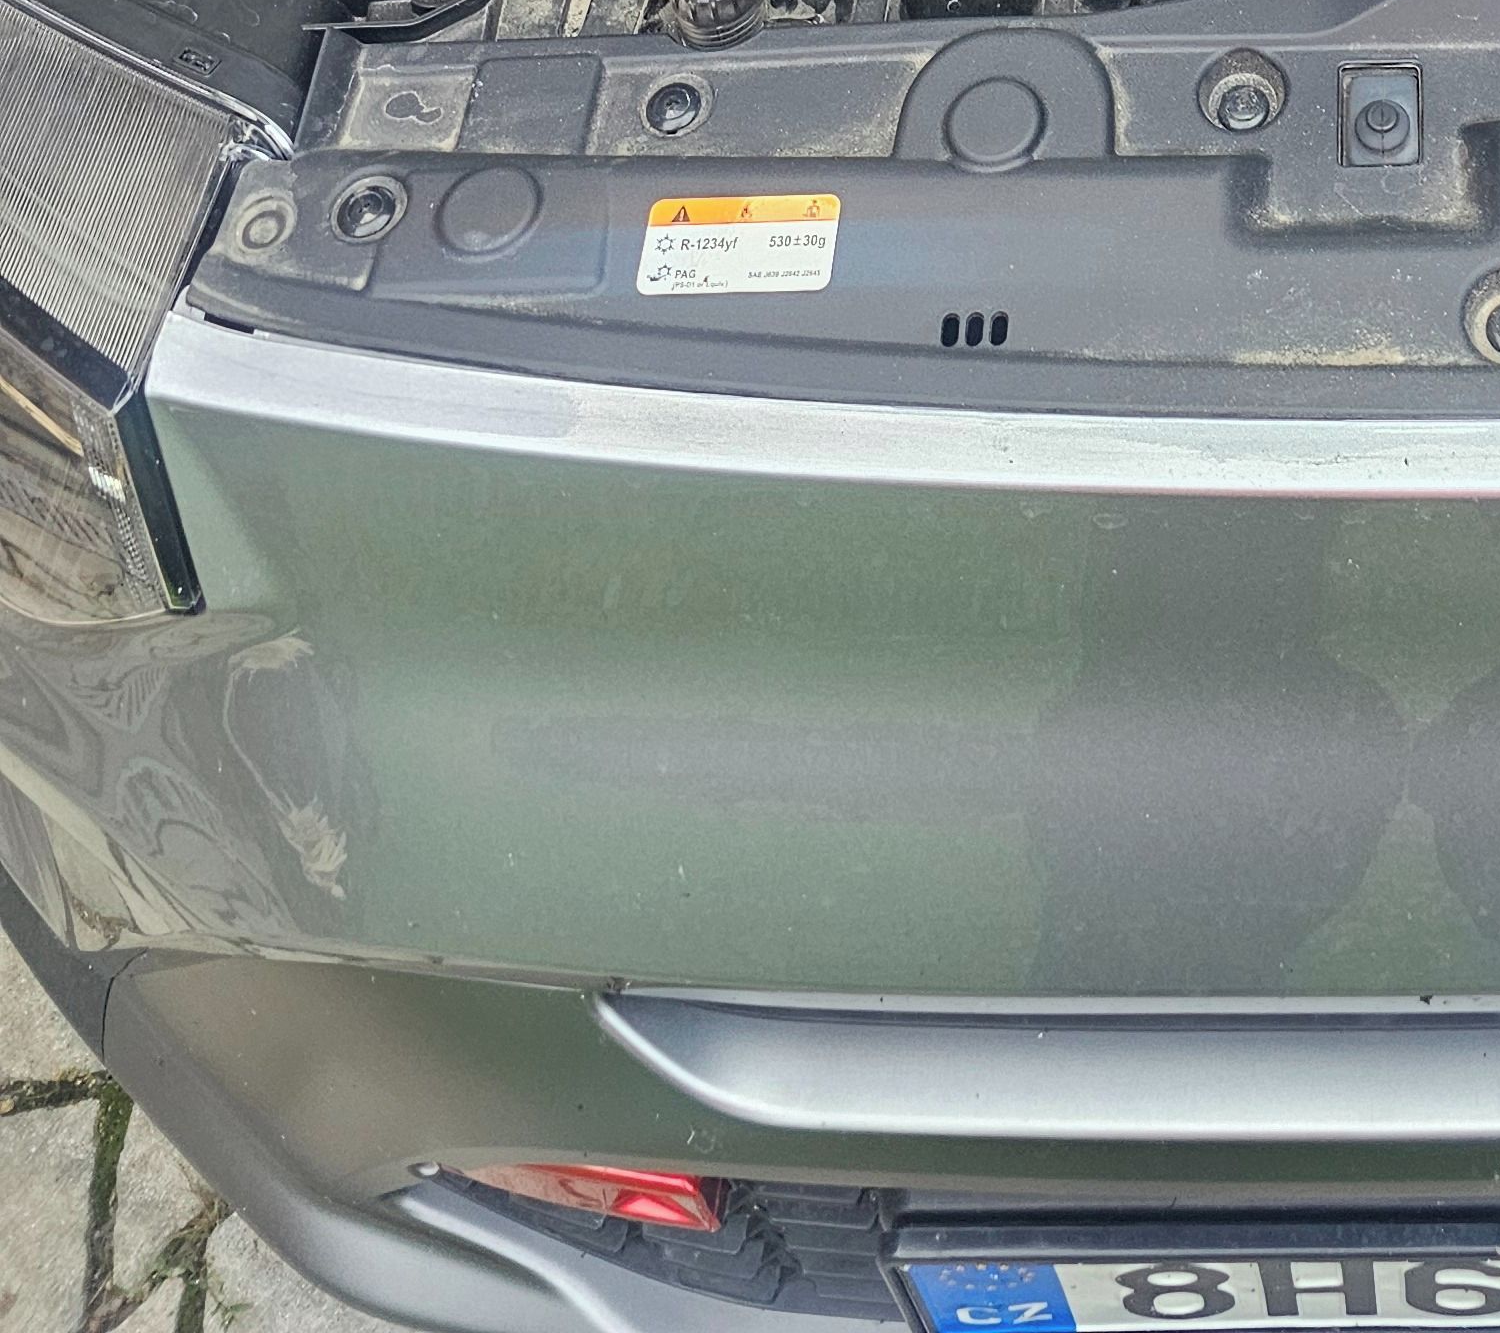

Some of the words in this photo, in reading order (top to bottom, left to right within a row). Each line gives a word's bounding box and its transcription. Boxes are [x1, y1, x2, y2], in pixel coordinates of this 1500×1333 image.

[680, 236, 739, 252] R-1234yf
[769, 234, 827, 250] 530±30g
[674, 269, 697, 279] PAG
[955, 1301, 1053, 1326] CZ
